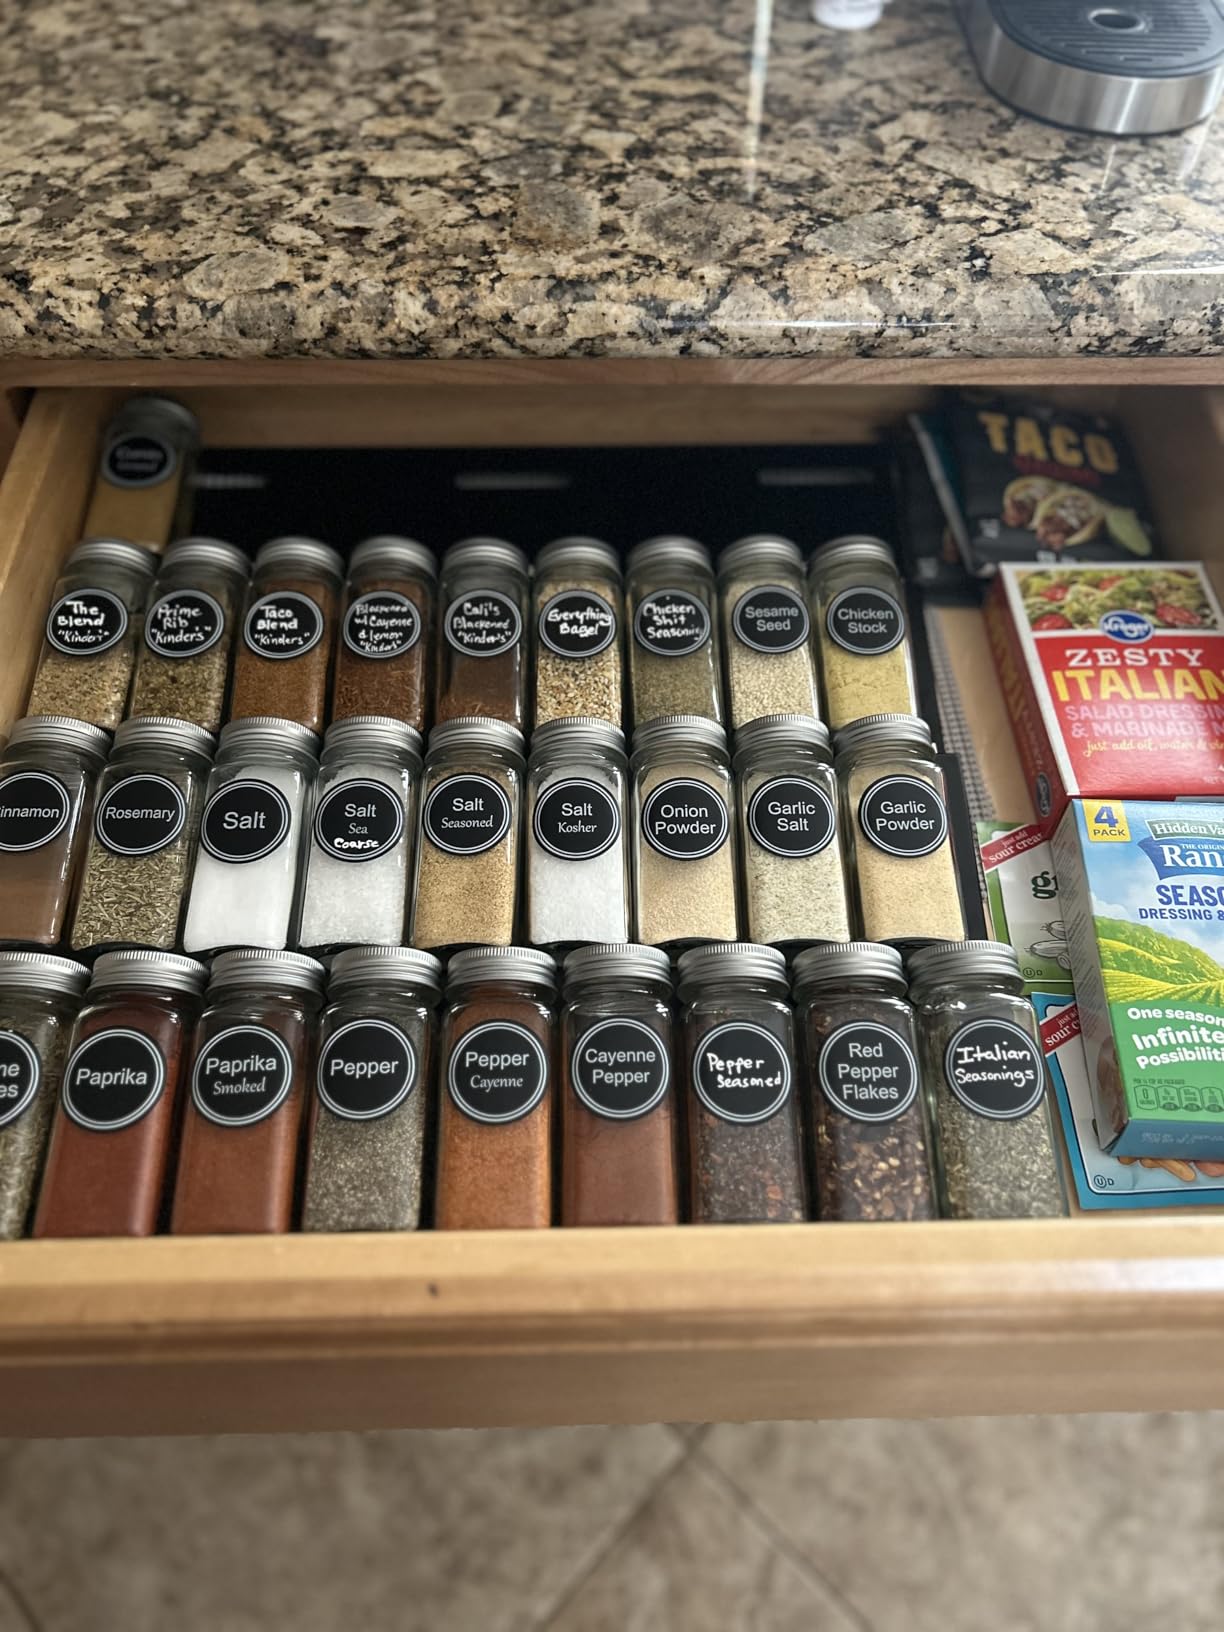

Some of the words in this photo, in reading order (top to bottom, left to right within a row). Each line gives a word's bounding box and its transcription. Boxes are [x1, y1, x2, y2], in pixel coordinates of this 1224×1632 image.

[978, 412, 1118, 473] TACO
[65, 601, 99, 615] The
[157, 604, 203, 620] Prime
[259, 605, 294, 619] Taco
[642, 602, 696, 616] Chicken
[745, 606, 799, 619] Sesame
[837, 607, 894, 621] Chicken
[57, 612, 105, 627] Blend
[162, 616, 189, 631] Rib
[369, 615, 413, 629] Cayenne
[453, 616, 511, 631] Blackened
[547, 605, 613, 627] Everything
[652, 613, 687, 627] Shit
[256, 619, 299, 631] Blend
[559, 622, 600, 638] Bagel
[756, 618, 791, 632] Seed
[848, 621, 888, 634] Stock
[1065, 648, 1204, 667] ZESTY
[1064, 704, 1134, 721] SALAD
[1071, 722, 1089, 738] &
[344, 803, 377, 818] Salt
[452, 797, 485, 812] Salt
[561, 802, 593, 817] Salt
[660, 803, 709, 818] Onion
[767, 801, 816, 816] Garlic
[880, 801, 927, 815] Garlic
[106, 806, 175, 822] Rosemary
[222, 811, 267, 830] Salt
[1094, 806, 1119, 828] 4
[348, 823, 369, 834] Sea
[441, 815, 494, 829] Seasoned
[557, 820, 598, 834] Kosher
[655, 821, 717, 835] Powder
[776, 817, 810, 832] Salt
[875, 818, 935, 832] Powder
[1152, 822, 1208, 835] Hidden
[1093, 829, 1126, 837] PACK
[334, 837, 380, 849] Coarse
[988, 845, 1016, 863] sour
[1138, 908, 1213, 921] DRESSING
[1127, 1007, 1162, 1020] One
[1044, 1025, 1071, 1047] sour
[1132, 1024, 1224, 1050] Infinite
[585, 1048, 656, 1066] Cayenne
[848, 1042, 883, 1058] Red
[956, 1041, 1031, 1064] Italian
[206, 1055, 277, 1077] Paprika
[330, 1059, 399, 1079] Pepper
[465, 1052, 529, 1071] Pepper
[706, 1052, 765, 1076] Pepper
[76, 1067, 148, 1089] Paprika
[592, 1069, 650, 1087] Pepper
[716, 1071, 781, 1088] Seasoned
[837, 1063, 899, 1082] Pepper
[955, 1065, 1035, 1087] Seasonings
[213, 1076, 266, 1095] Smoked
[470, 1074, 524, 1093] Cayenne
[842, 1083, 899, 1100] Flakes
